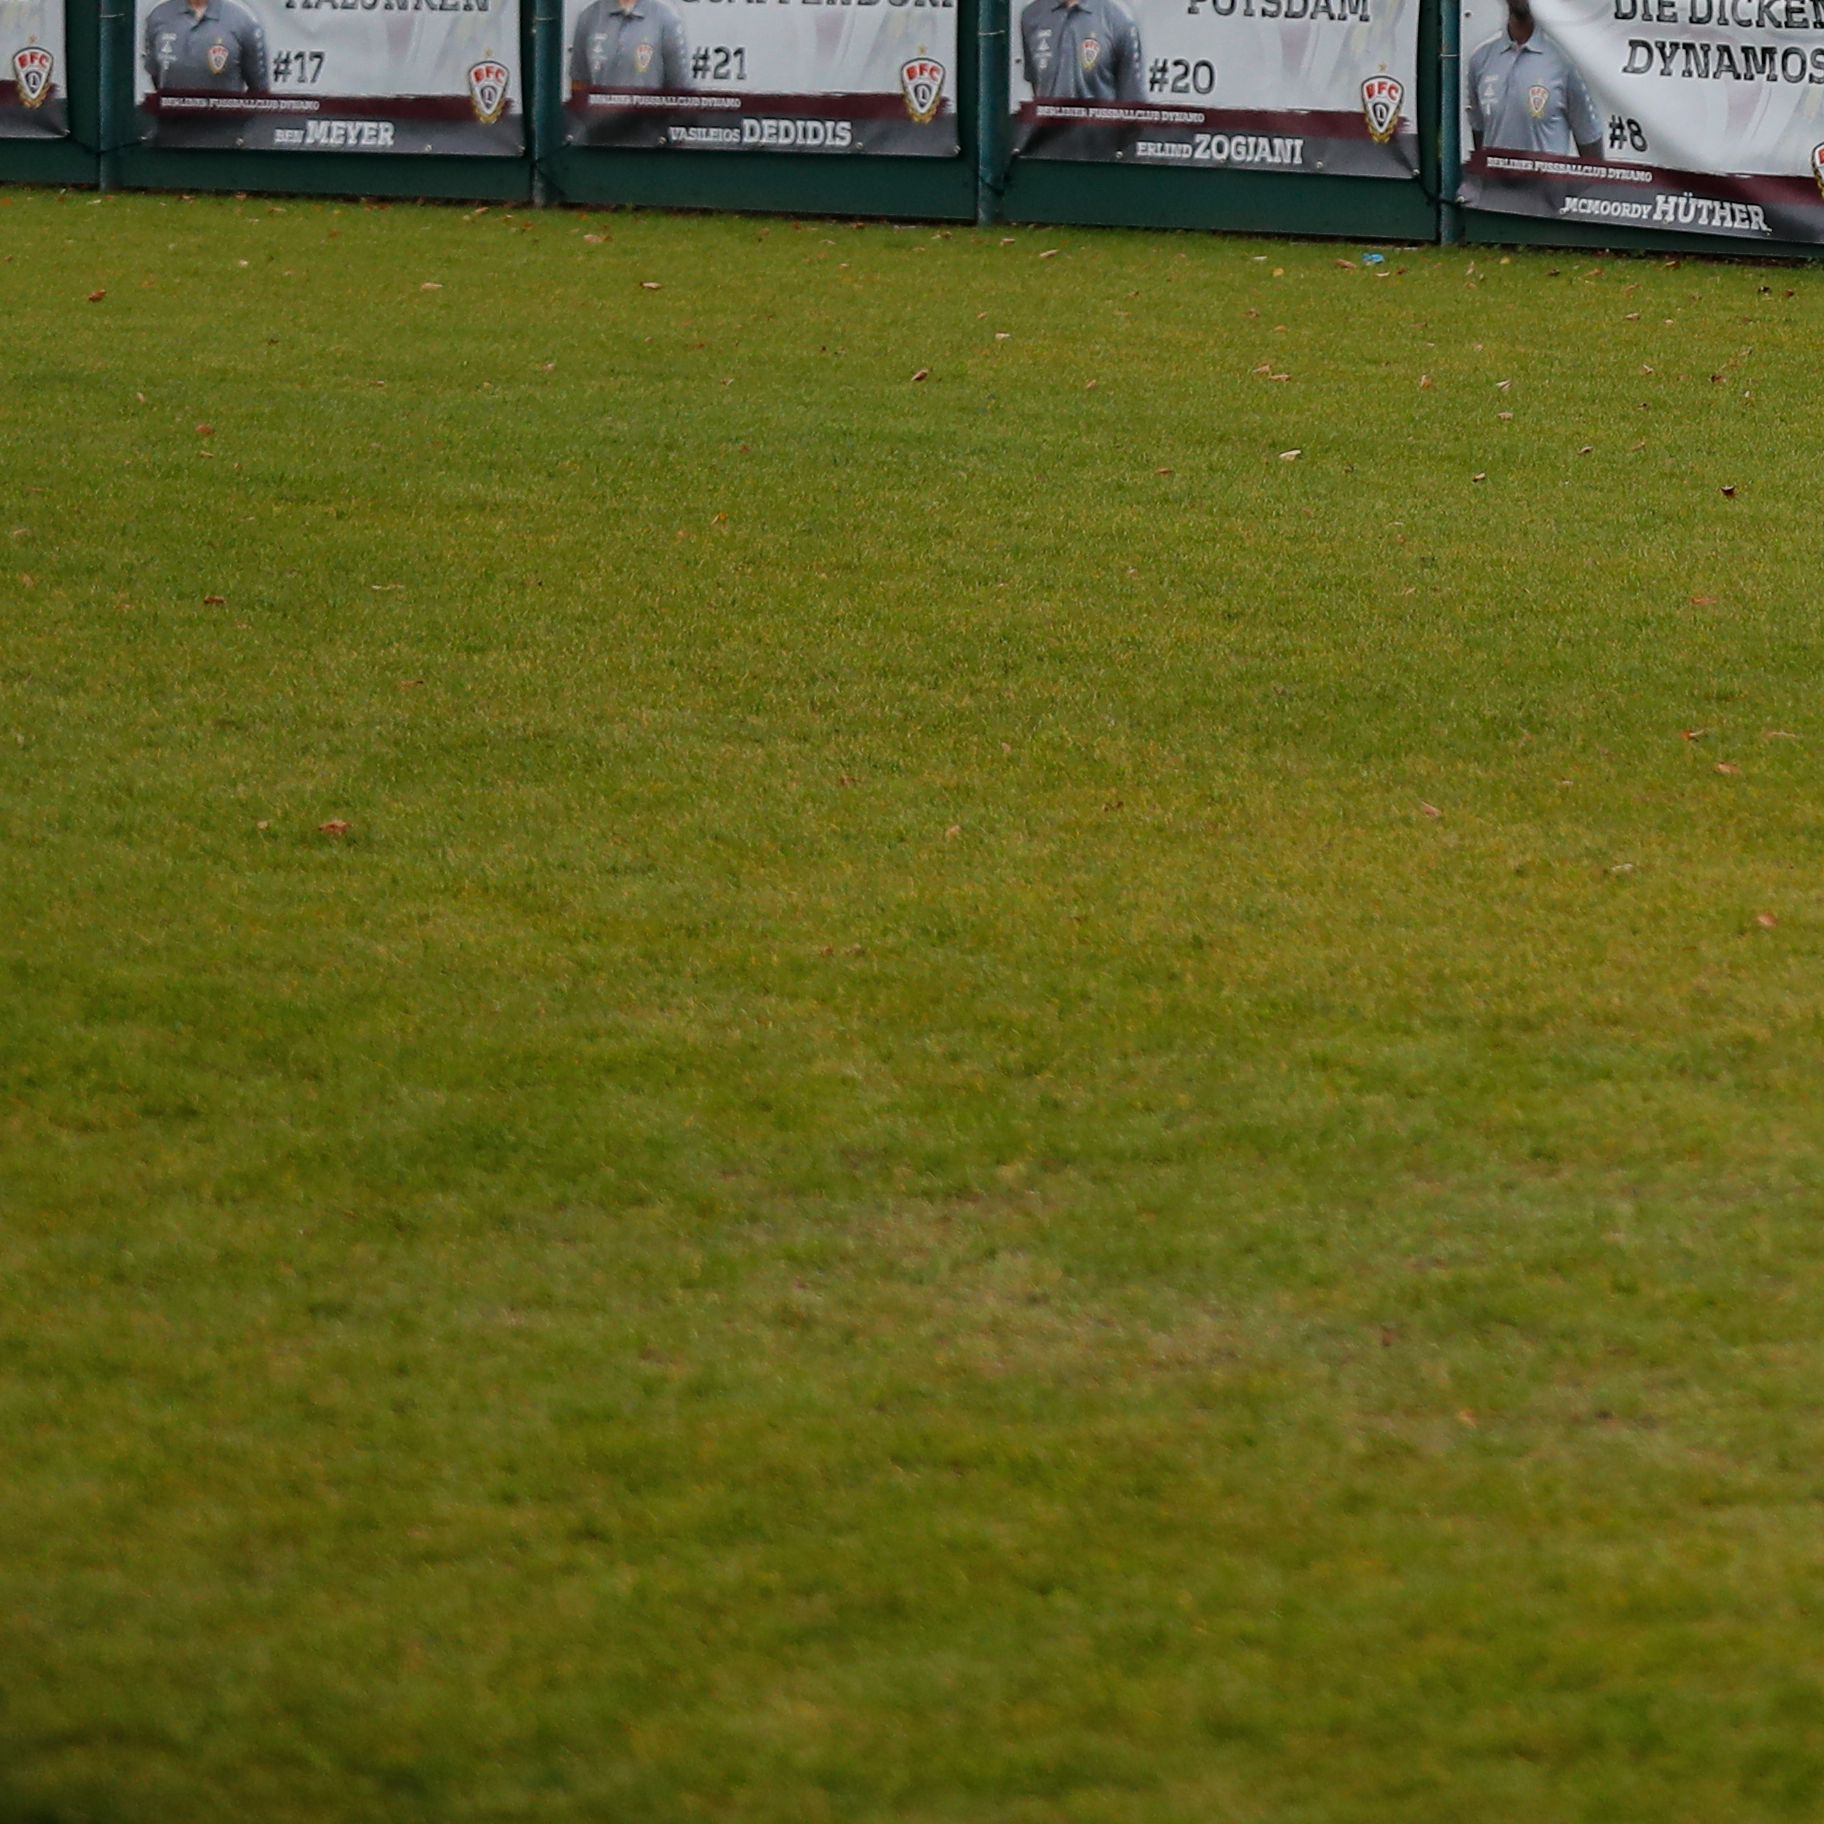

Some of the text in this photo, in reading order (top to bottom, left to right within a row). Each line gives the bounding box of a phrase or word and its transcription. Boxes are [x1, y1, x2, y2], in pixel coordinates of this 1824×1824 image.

[273, 51, 326, 83] #17
[691, 46, 748, 80] #21
[905, 63, 939, 80] BFC
[1149, 59, 1216, 94] #20
[1365, 81, 1399, 101] BFC
[274, 119, 395, 146] BEN MEYER
[669, 119, 852, 146] VASILEIOS DEDIDIS
[1609, 115, 1648, 152] #8
[1137, 134, 1303, 165] ERLIND ZOGJANI
[1563, 192, 1770, 231] MCMOORDY HÜTHER
